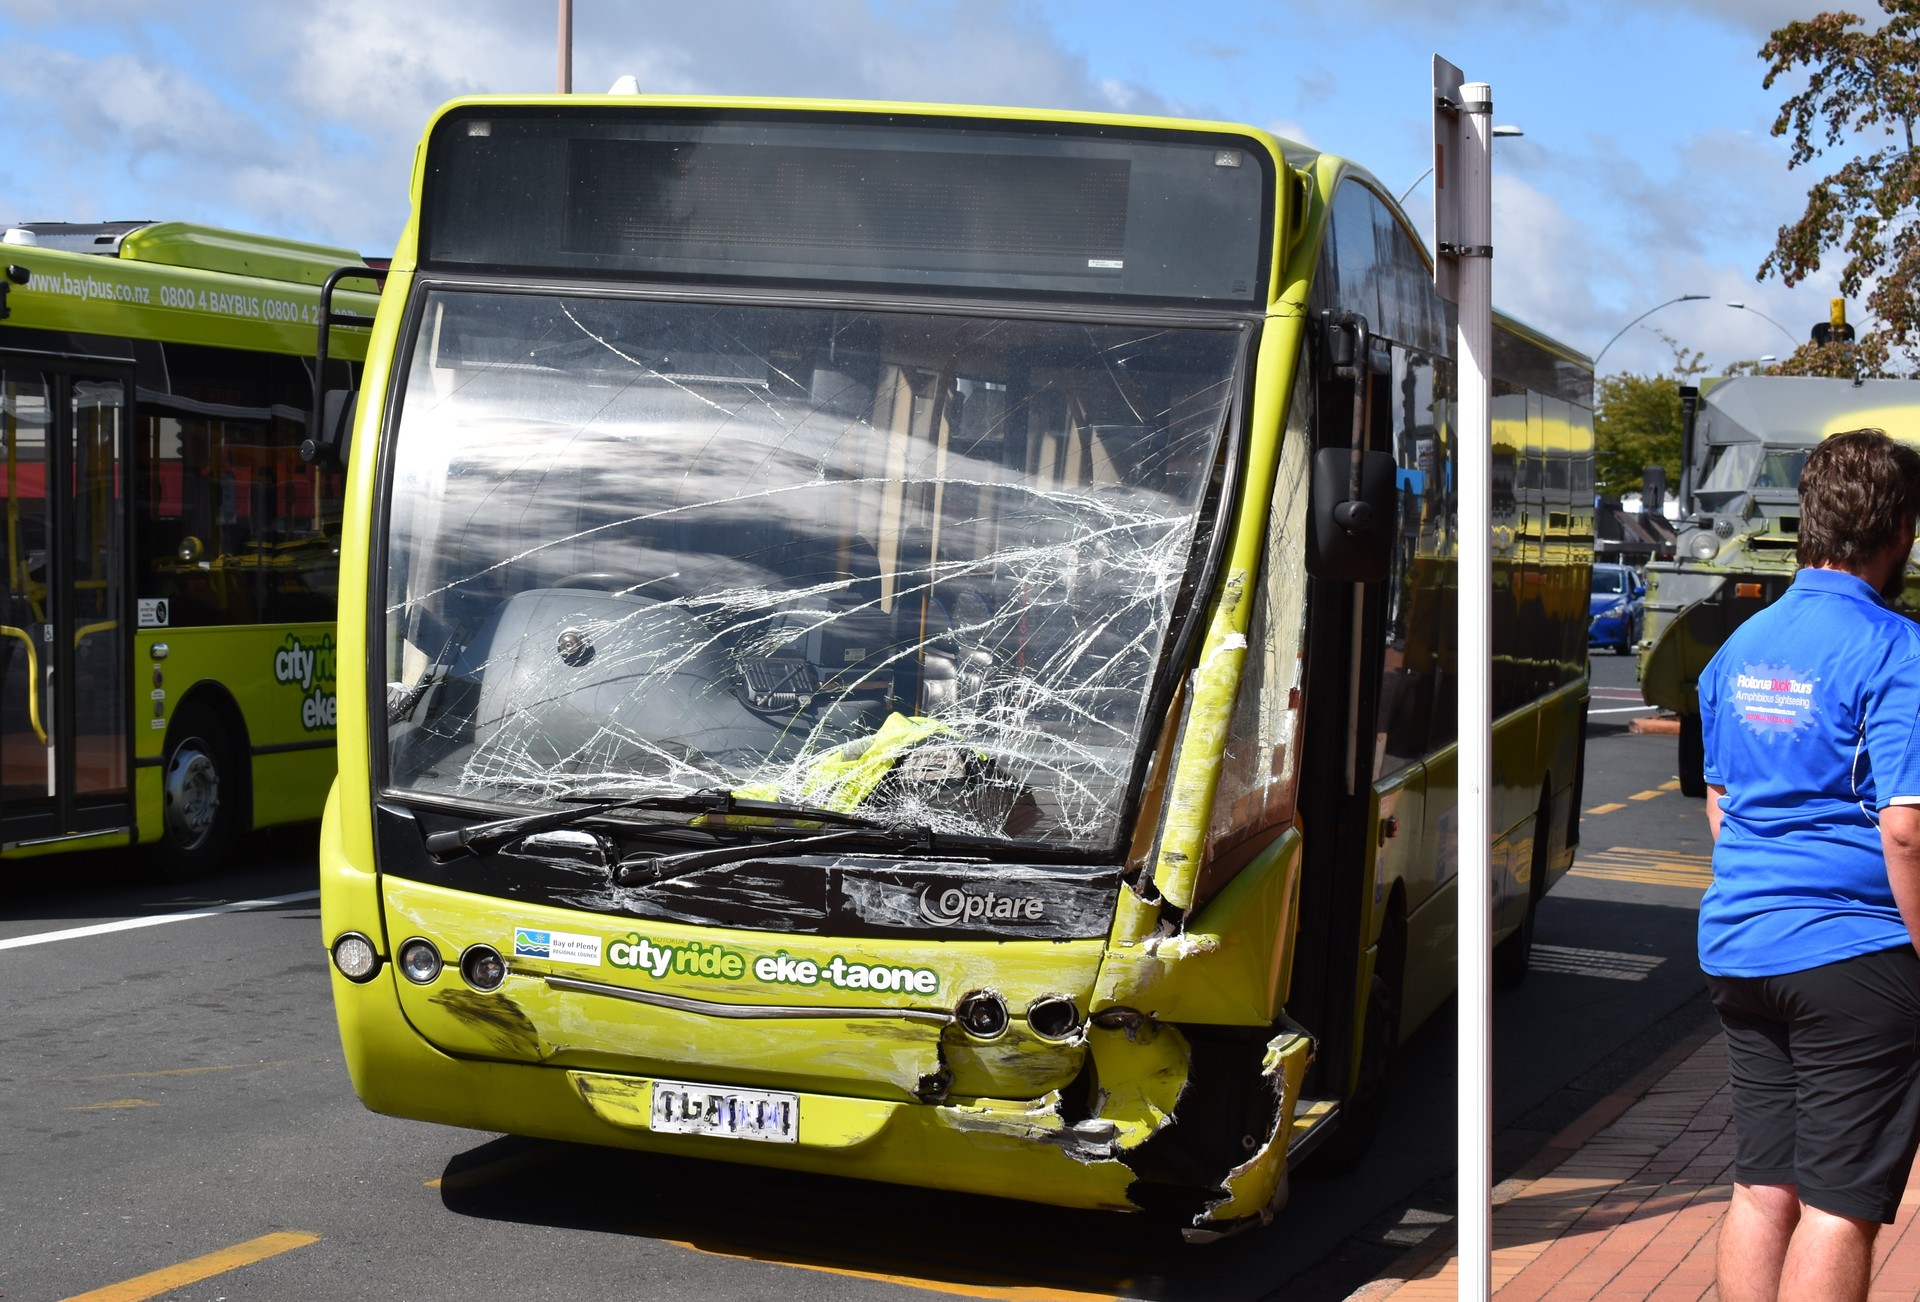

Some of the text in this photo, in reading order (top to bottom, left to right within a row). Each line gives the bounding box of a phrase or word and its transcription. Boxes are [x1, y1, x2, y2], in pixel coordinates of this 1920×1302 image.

[26, 272, 150, 304] www.baybus.co.nz
[160, 285, 195, 309] 0800
[199, 290, 207, 311] 4
[209, 292, 260, 317] BAYBUS
[262, 299, 298, 322] (0800
[301, 304, 309, 324] 4
[1735, 690, 1810, 709] Amphibious Sightseeing
[940, 888, 1044, 923] Optare
[552, 948, 598, 959] REGIONAL COUNCIL
[553, 939, 566, 948] Bay
[576, 942, 598, 952] Plenty
